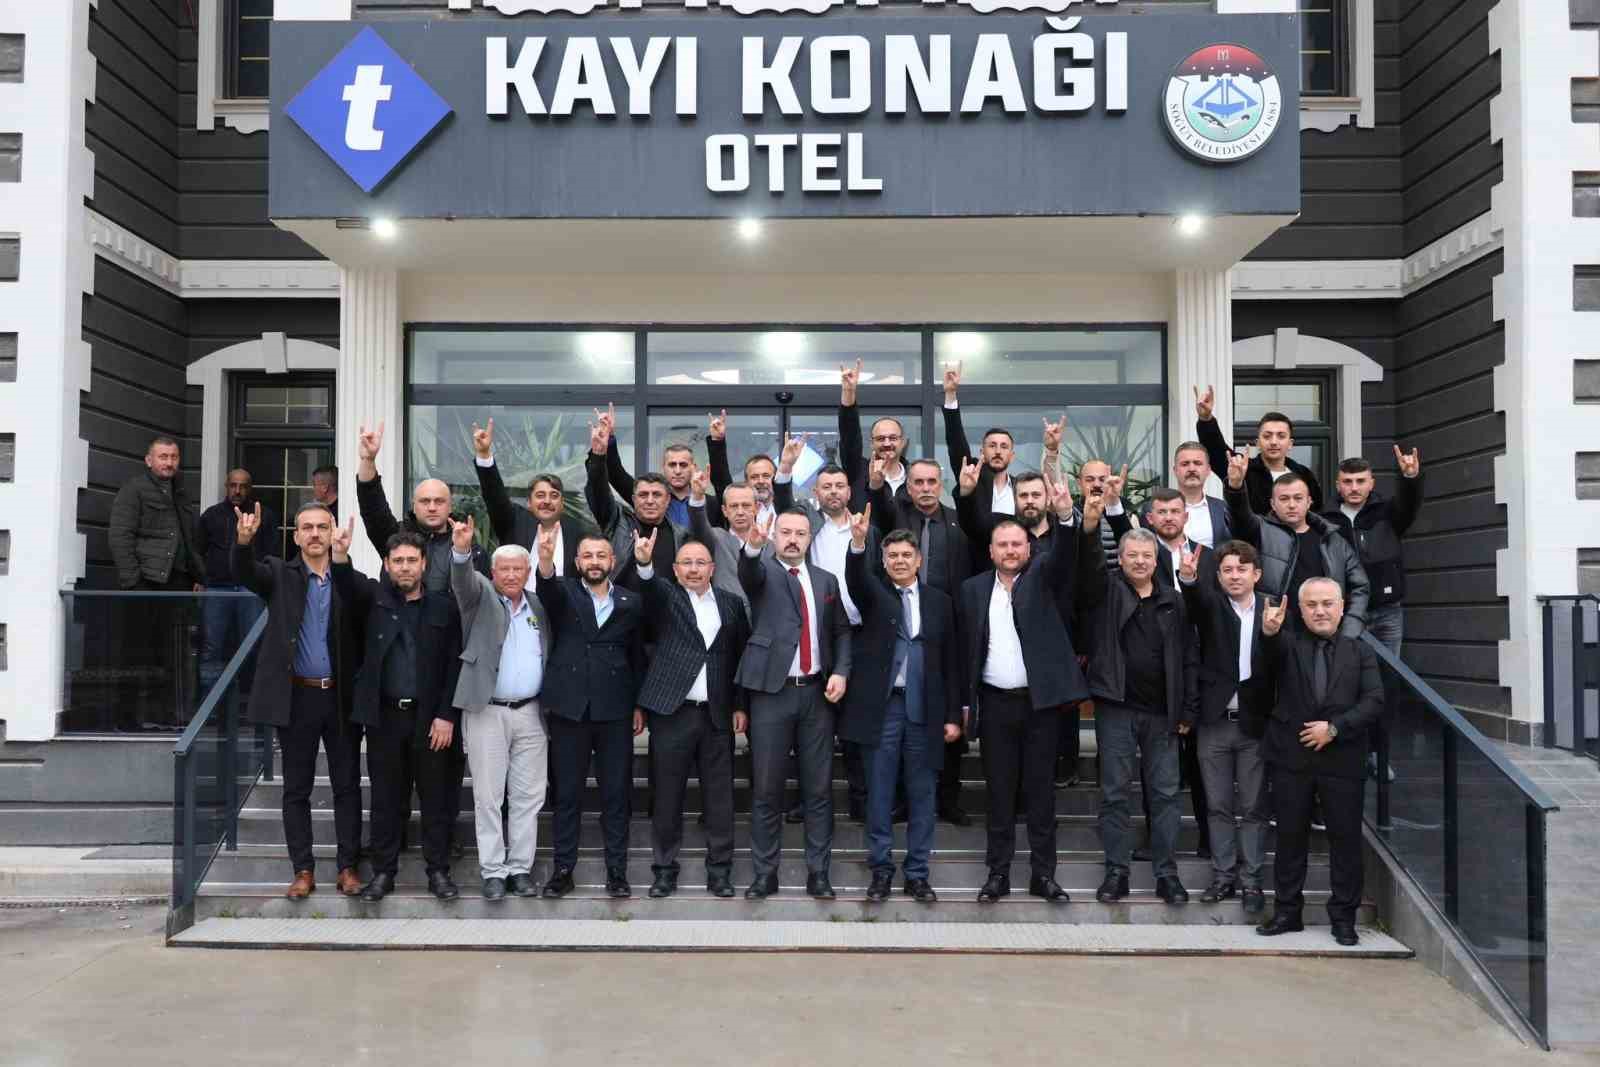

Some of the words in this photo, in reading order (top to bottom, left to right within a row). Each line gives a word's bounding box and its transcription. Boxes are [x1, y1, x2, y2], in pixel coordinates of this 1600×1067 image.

[342, 65, 393, 151] t
[486, 36, 698, 115] KAYI
[742, 16, 1128, 114] KONAĞI
[705, 133, 884, 192] OTEL
